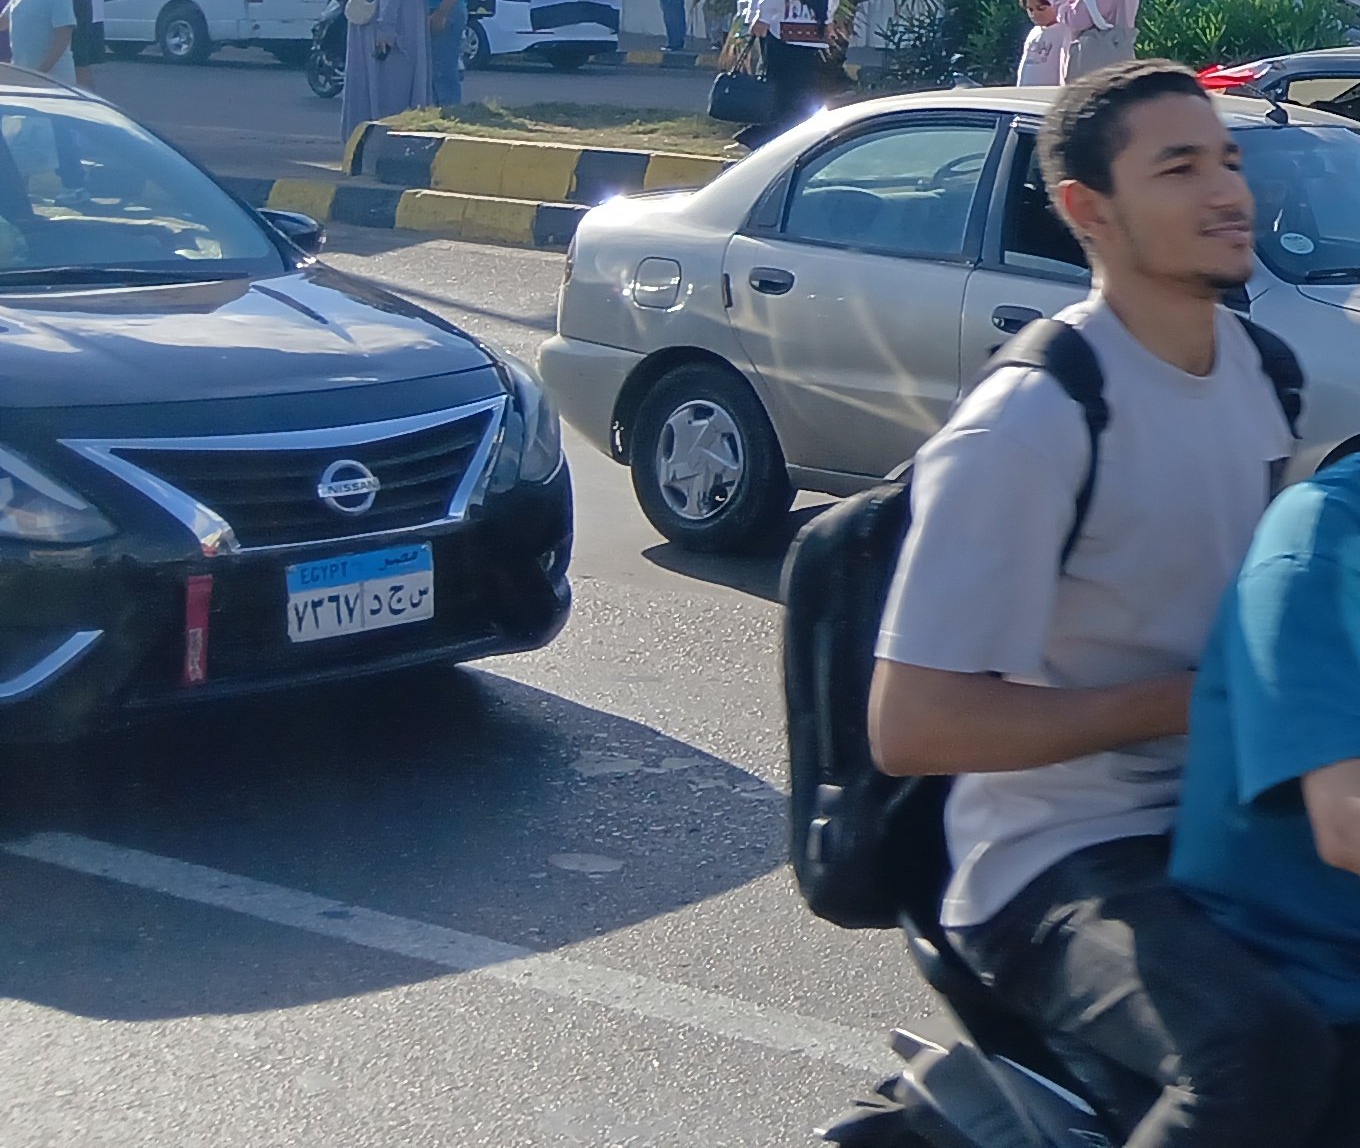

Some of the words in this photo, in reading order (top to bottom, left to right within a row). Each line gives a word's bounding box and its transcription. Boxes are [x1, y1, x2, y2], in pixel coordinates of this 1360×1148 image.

[327, 479, 376, 494] NISSAN
[300, 560, 349, 584] EGYPT
[377, 550, 420, 572] مصر
